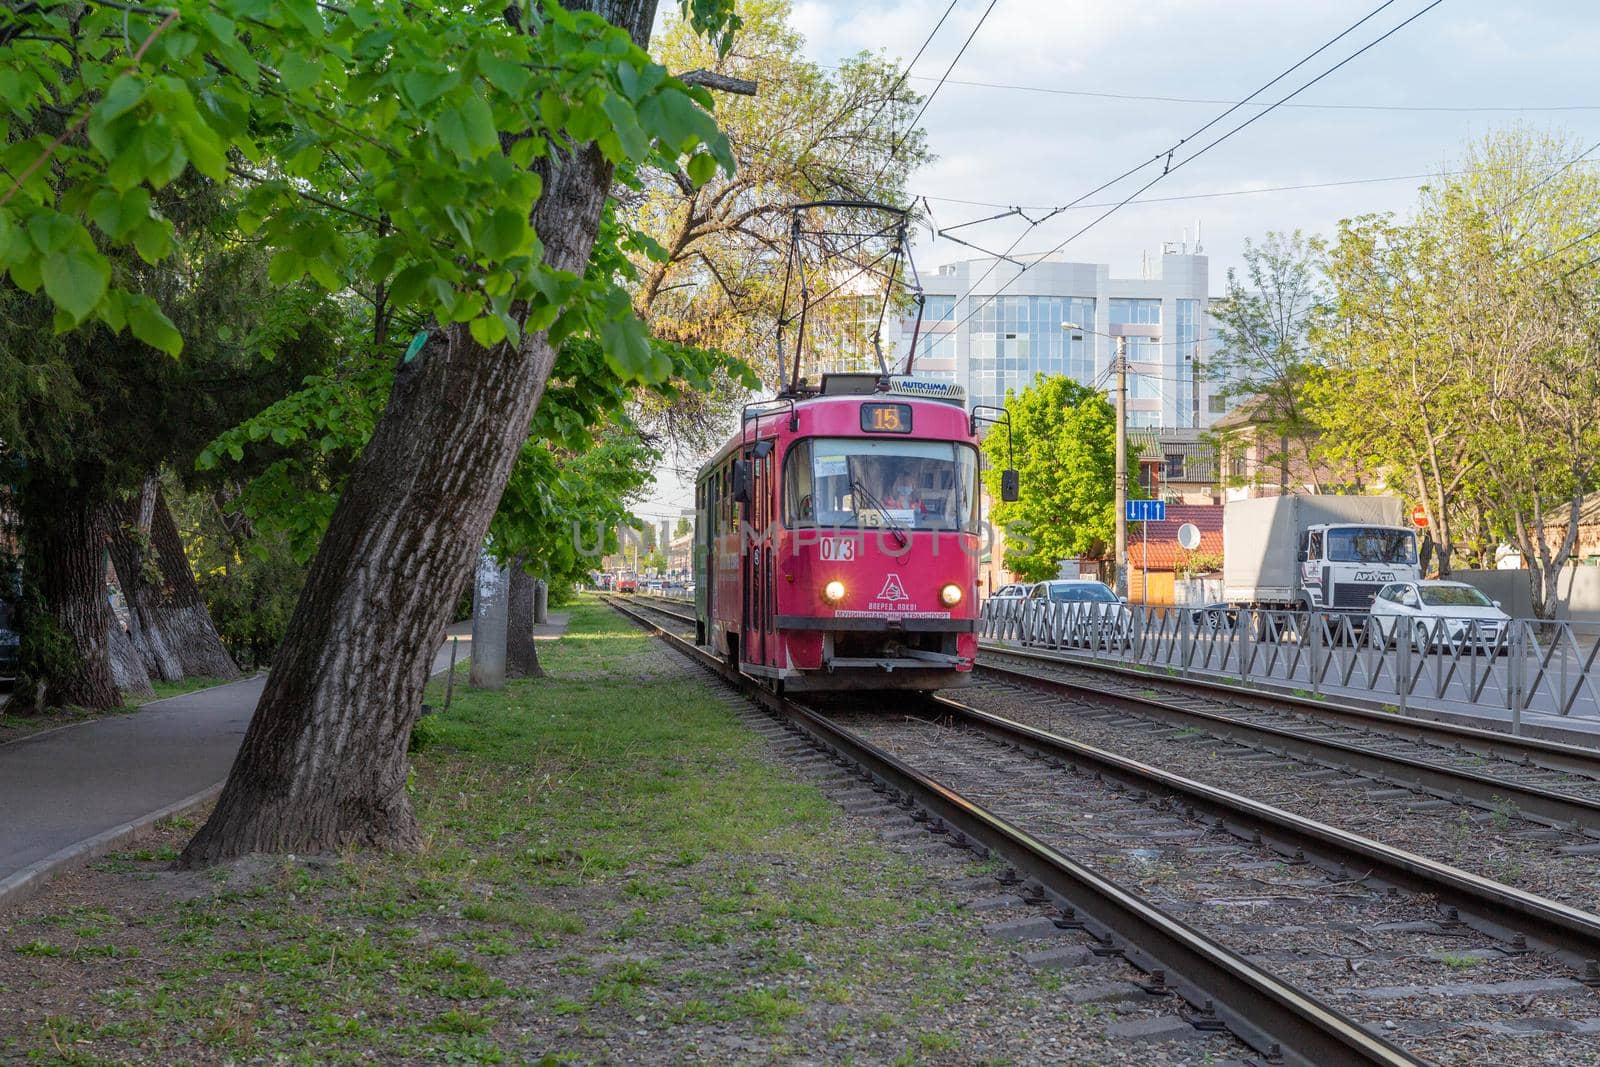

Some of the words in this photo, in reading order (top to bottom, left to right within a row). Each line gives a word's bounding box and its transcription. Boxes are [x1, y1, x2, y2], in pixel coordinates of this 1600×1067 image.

[902, 381, 947, 391] AUTOCLIMA
[873, 408, 898, 430] 15
[860, 513, 879, 526] 15
[822, 537, 853, 560] 073
